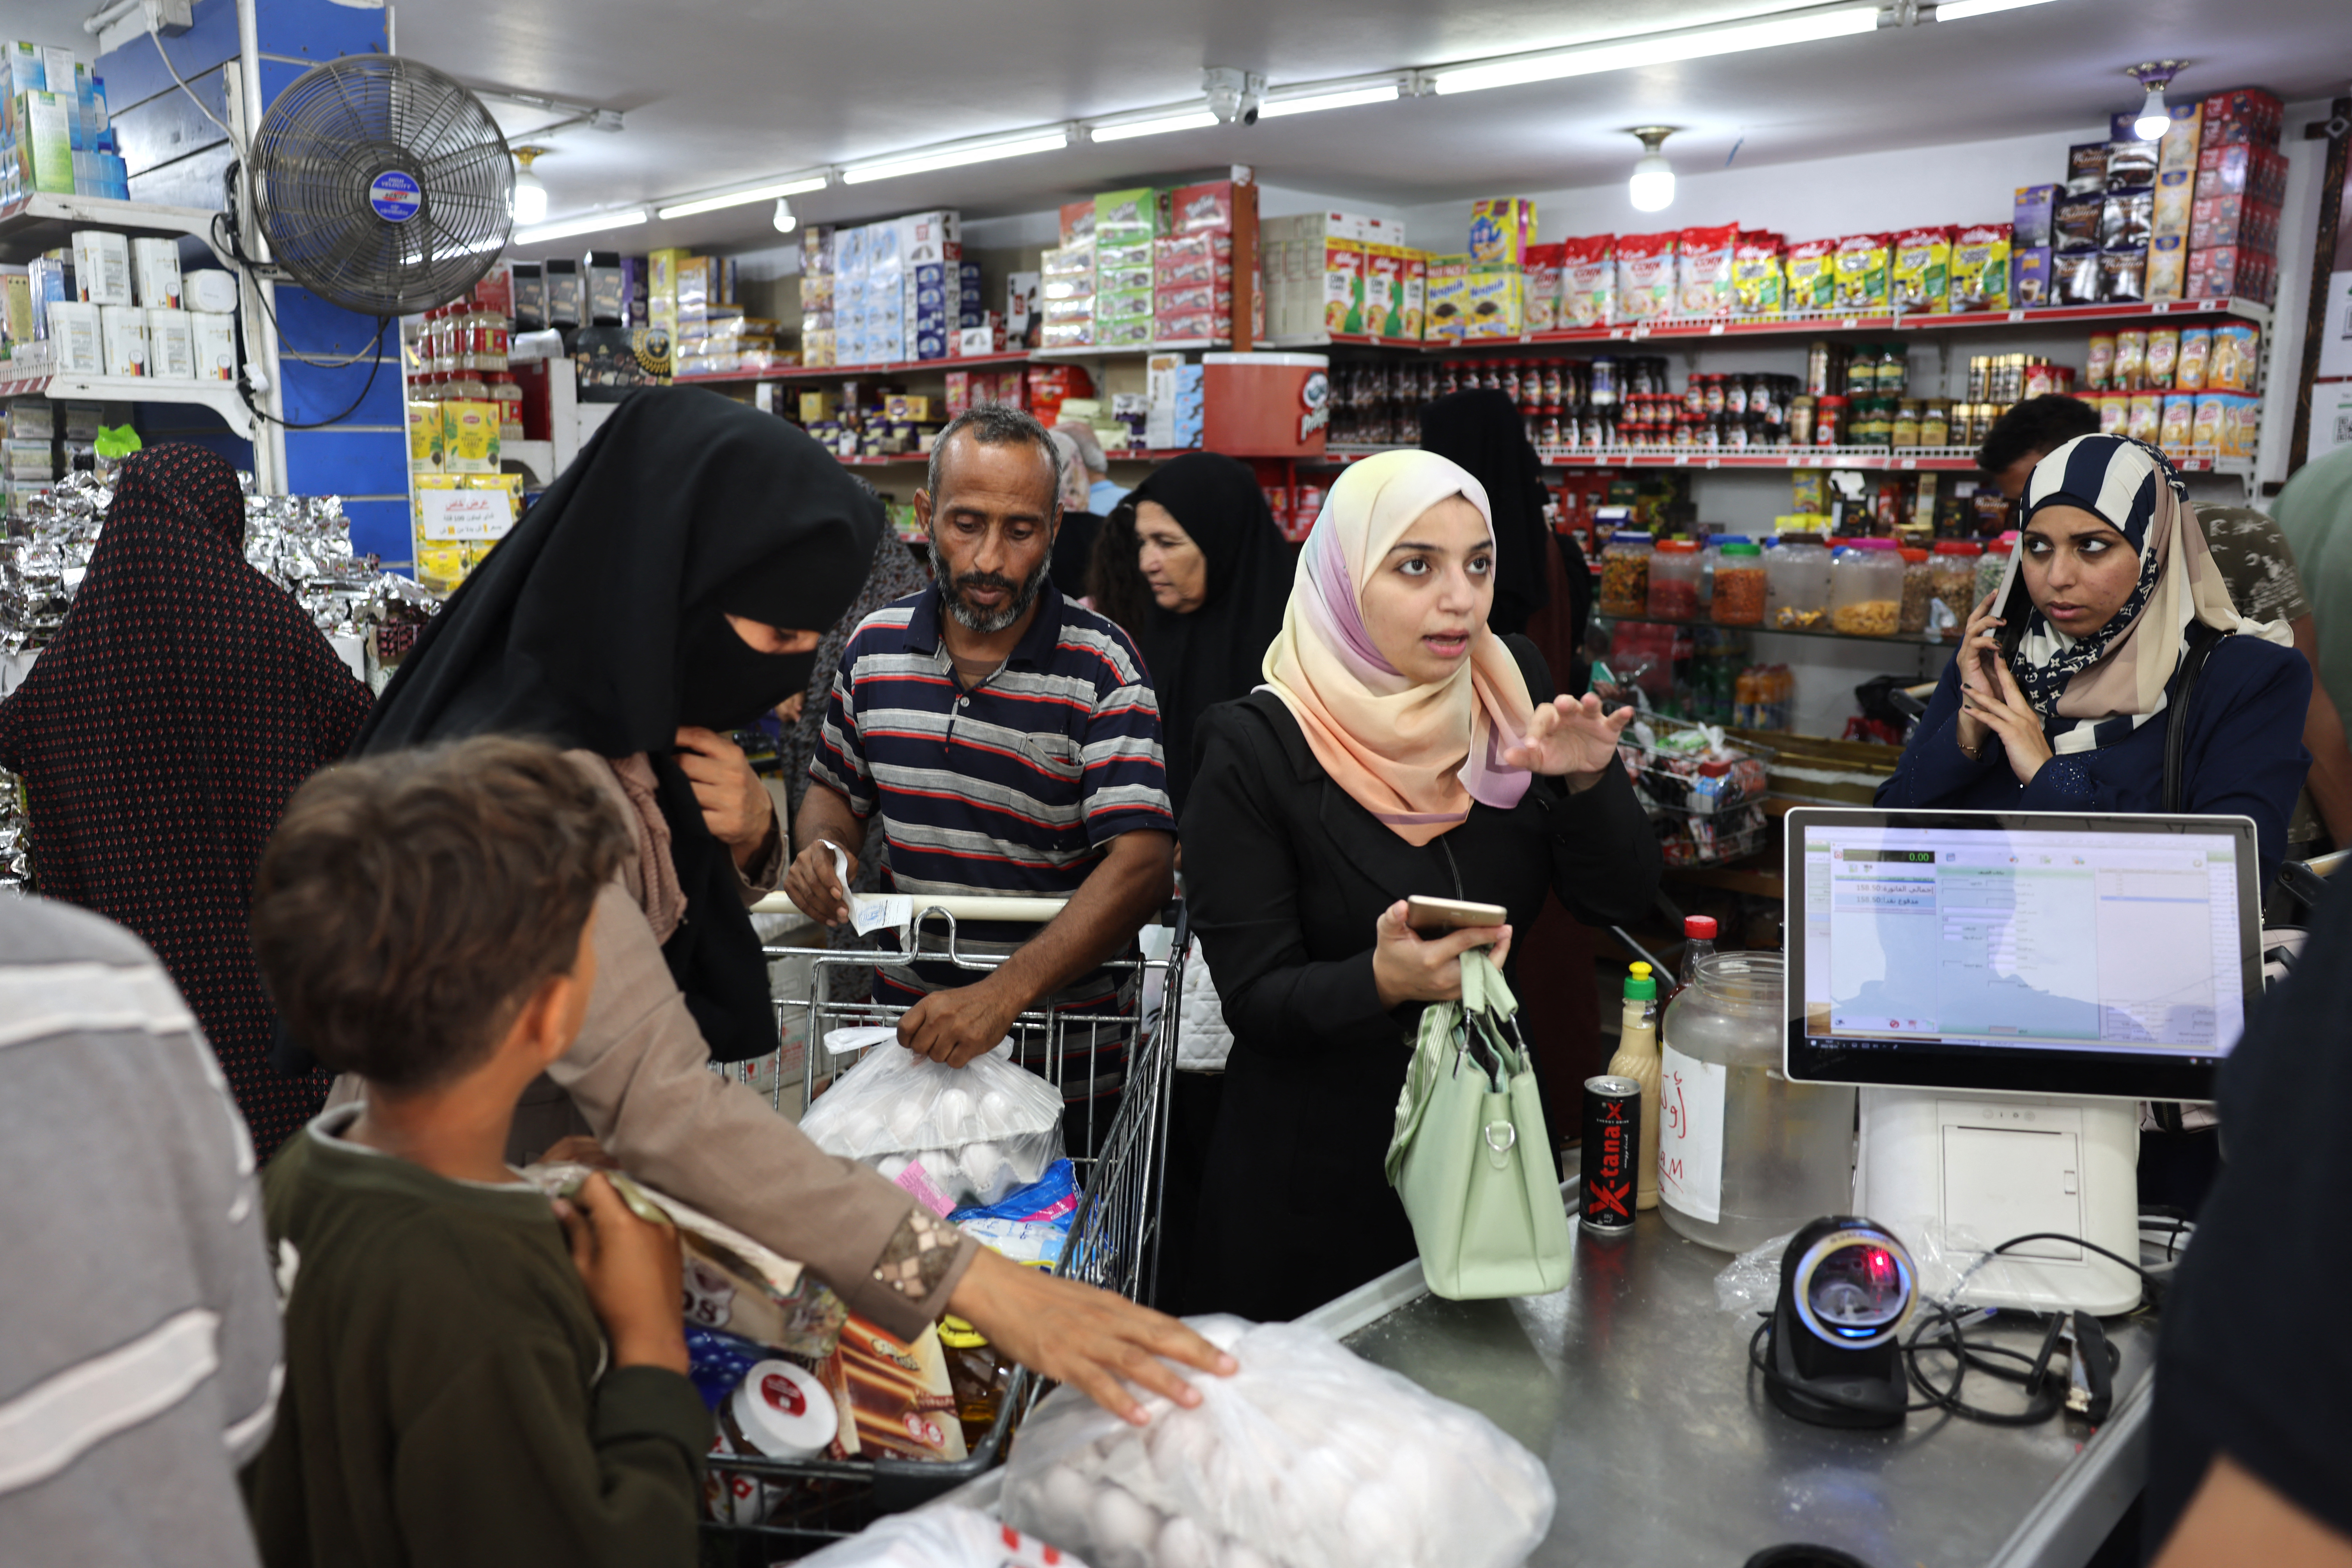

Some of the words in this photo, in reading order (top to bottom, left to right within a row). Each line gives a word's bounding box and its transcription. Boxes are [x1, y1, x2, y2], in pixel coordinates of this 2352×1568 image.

[381, 181, 411, 190] VELOCITY
[446, 498, 464, 510] خاص
[466, 499, 488, 510] عرض
[1909, 852, 1929, 861] 0.00
